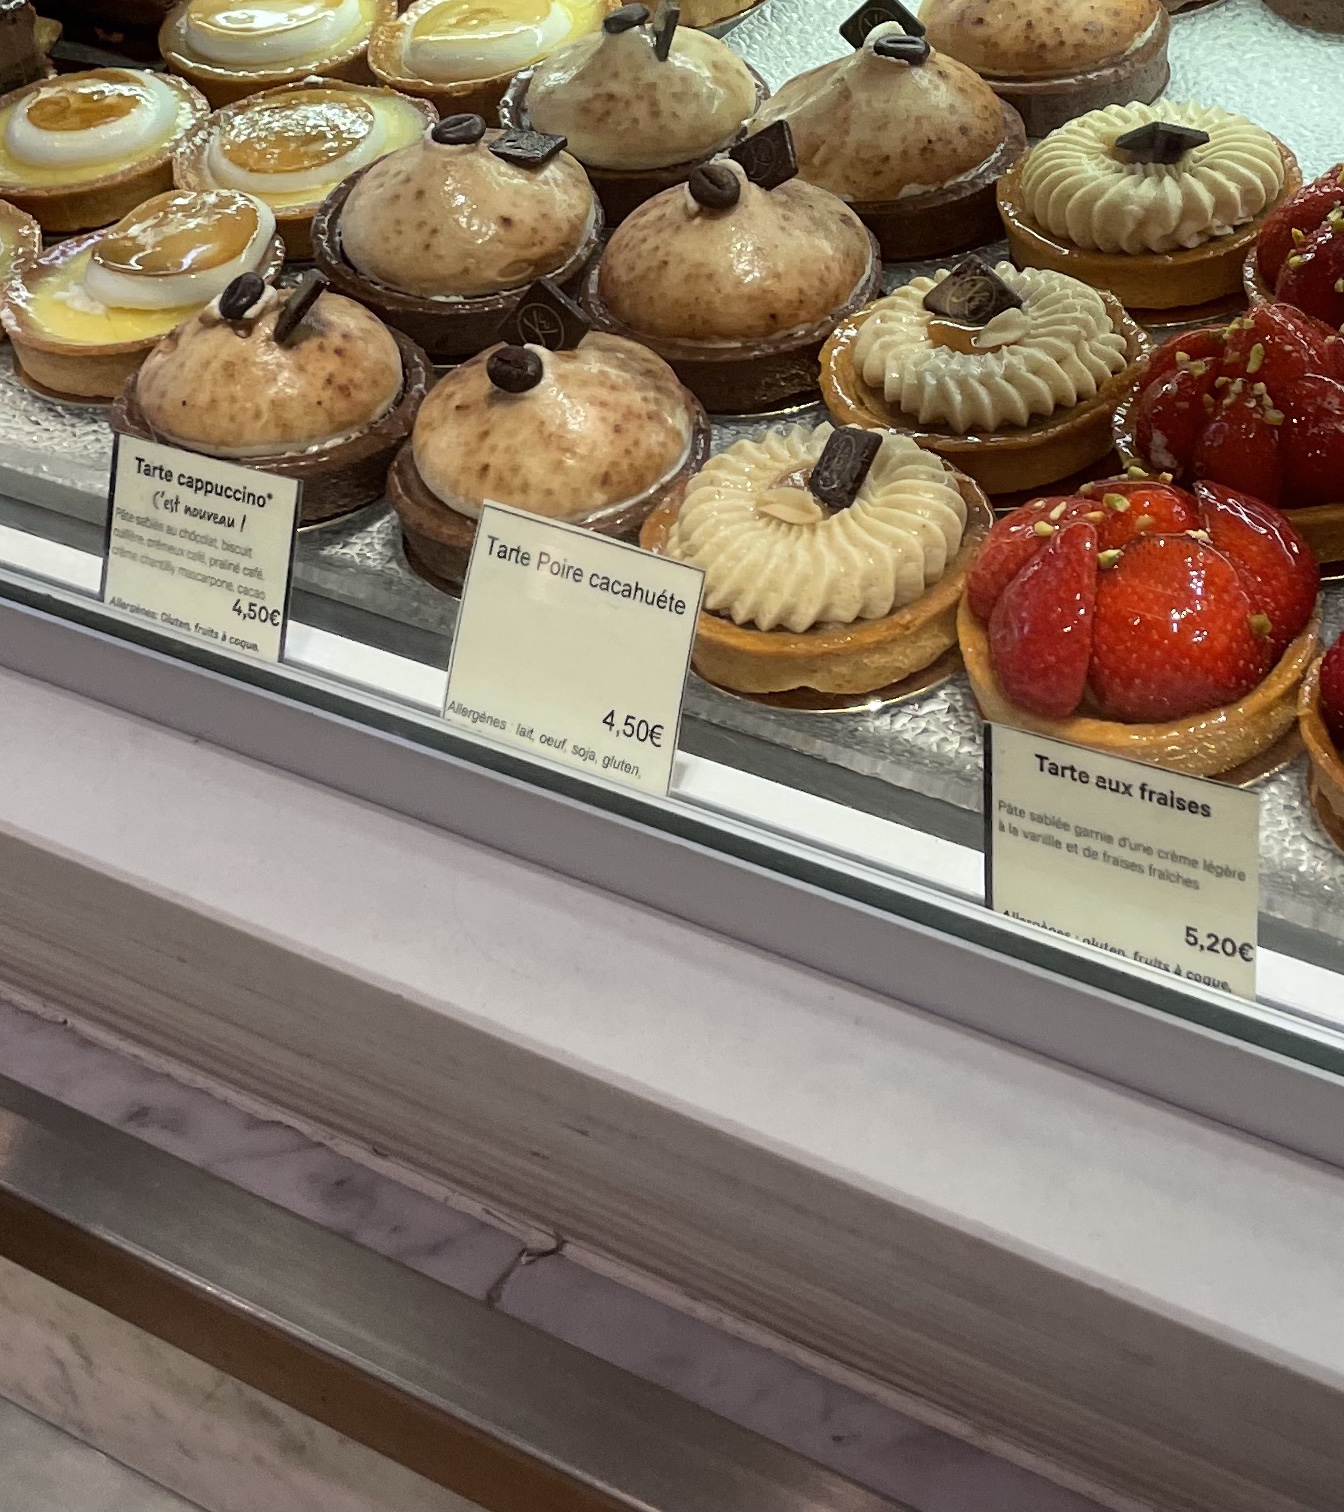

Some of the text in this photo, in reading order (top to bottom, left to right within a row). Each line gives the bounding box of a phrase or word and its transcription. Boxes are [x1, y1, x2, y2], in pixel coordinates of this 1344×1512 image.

[135, 456, 174, 483] Tarte
[184, 504, 236, 529] nouveau
[486, 534, 531, 567] Tarte
[536, 551, 584, 583] Poire
[232, 598, 281, 627] 4,50€
[602, 708, 665, 748] 4,50€
[1034, 753, 1213, 819] Tarte aux fraises
[1008, 821, 1019, 837] la
[1066, 841, 1079, 855] et
[1082, 846, 1099, 861] de
[1184, 924, 1255, 963] 5,20€
